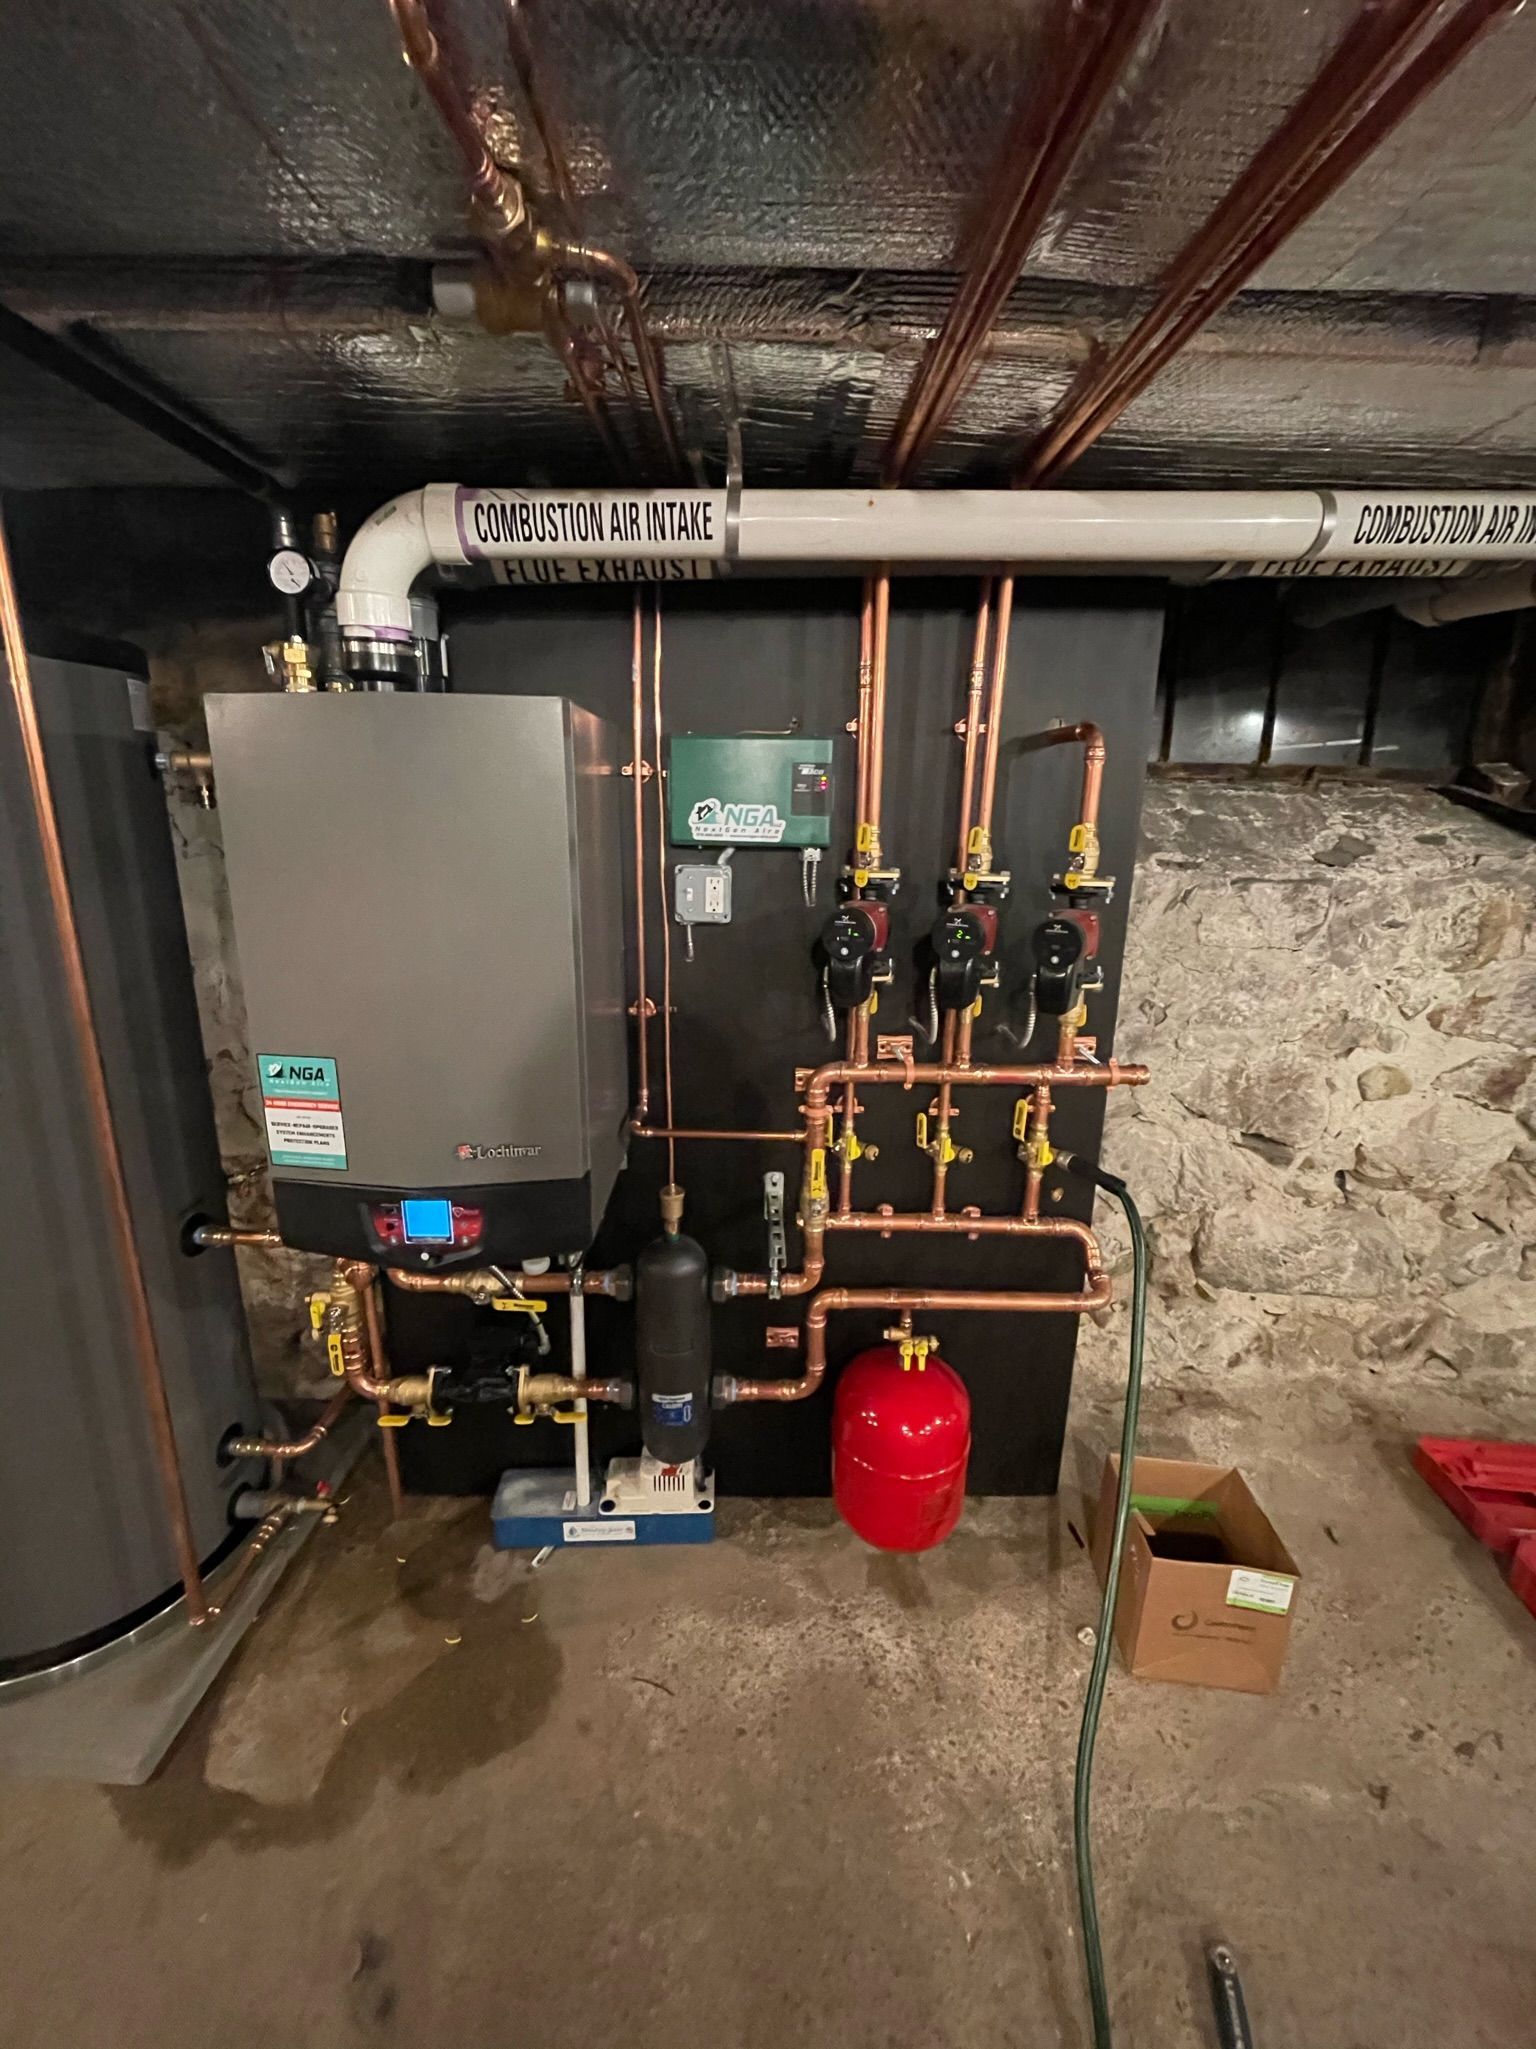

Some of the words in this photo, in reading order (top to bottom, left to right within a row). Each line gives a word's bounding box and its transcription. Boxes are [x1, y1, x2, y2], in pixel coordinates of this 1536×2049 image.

[475, 502, 604, 542] COMBUSTION
[610, 502, 641, 541] AIR
[646, 501, 713, 541] INTAKE
[1353, 504, 1485, 544] COMBUSTION
[1476, 504, 1519, 544] AIR
[724, 807, 775, 827] NGA
[289, 1066, 325, 1082] NGA
[477, 1144, 542, 1160] Lochinvar
